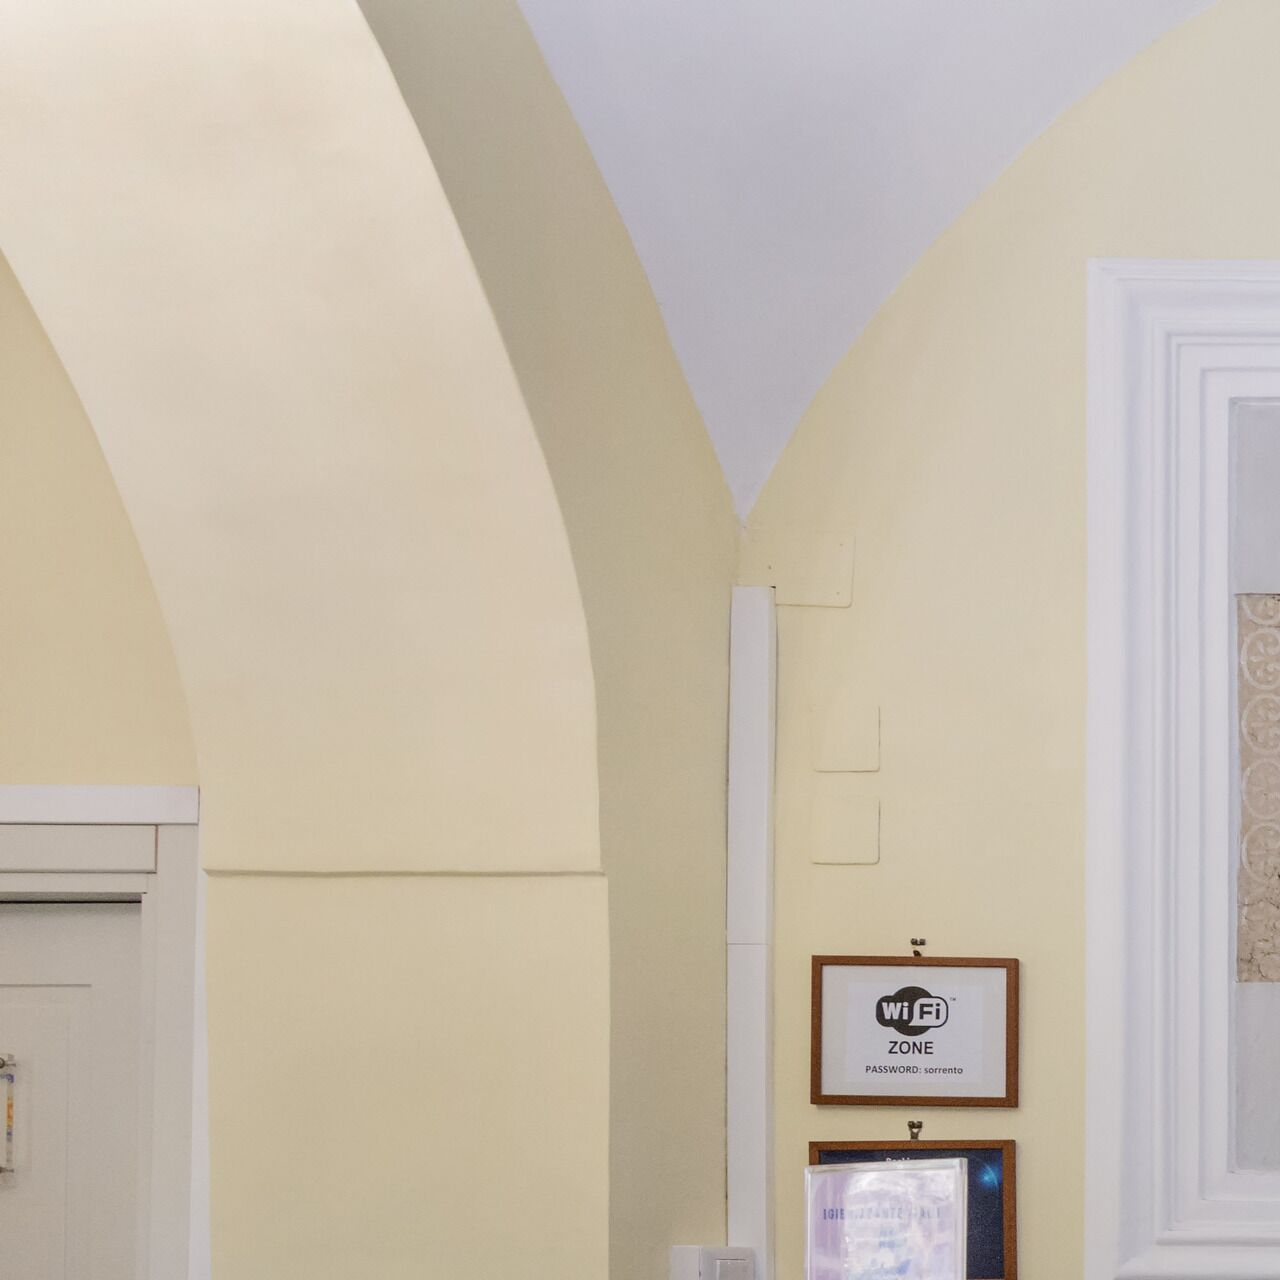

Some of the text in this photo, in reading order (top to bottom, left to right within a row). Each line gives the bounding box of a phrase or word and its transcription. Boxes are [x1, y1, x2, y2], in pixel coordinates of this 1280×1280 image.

[888, 1041, 934, 1055] ZONE
[865, 1065, 963, 1075] PASSWORD: sorrento
